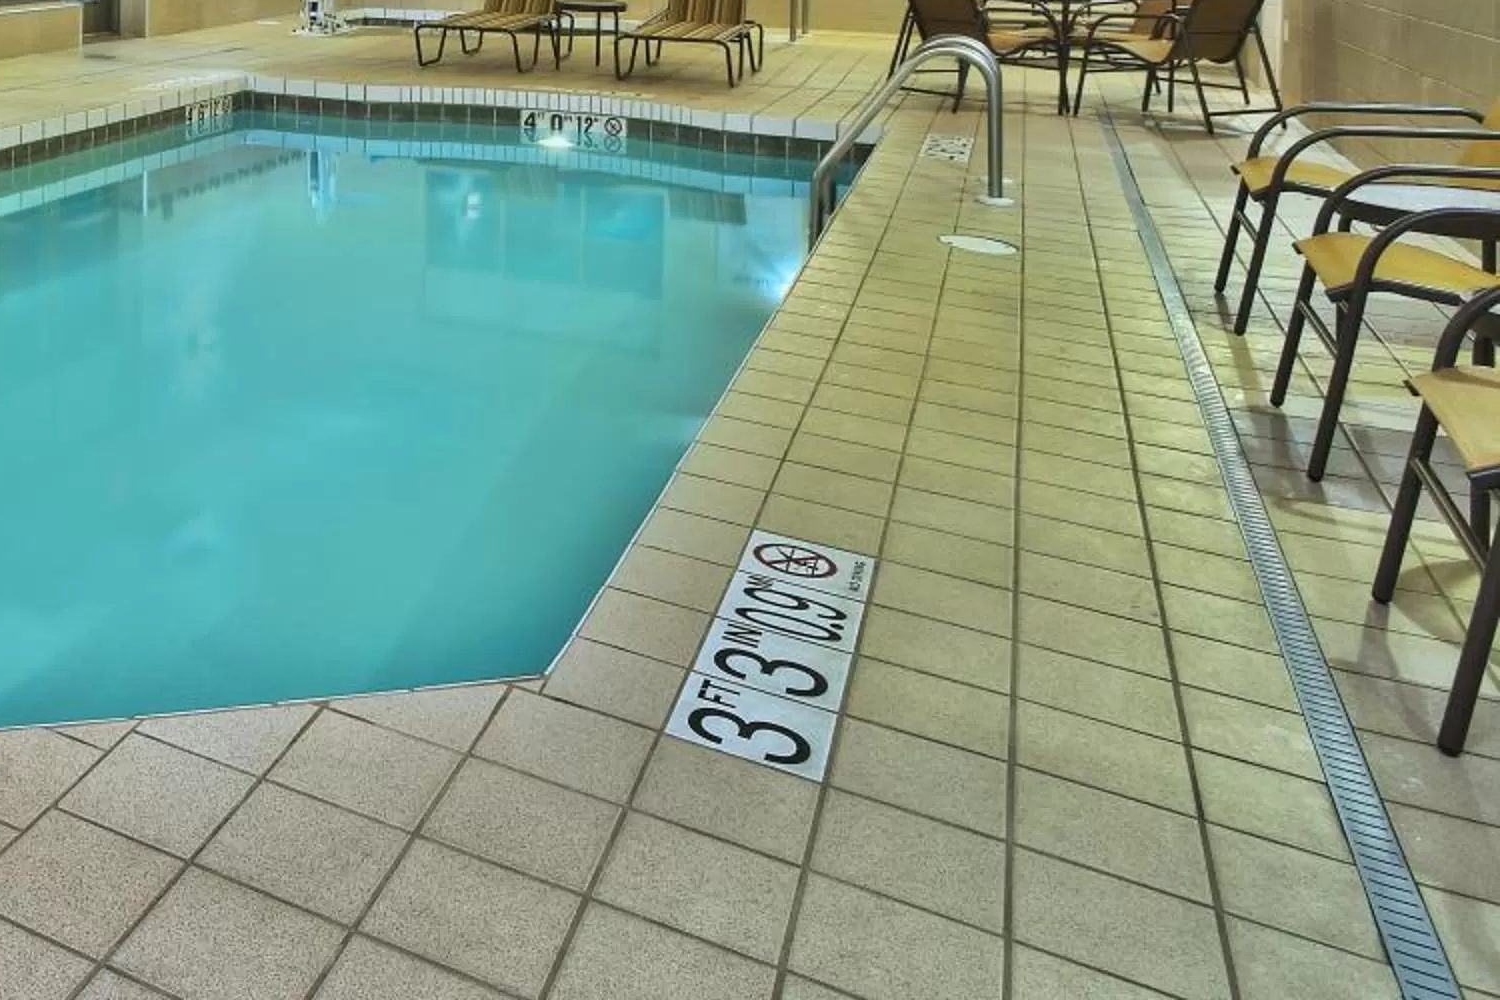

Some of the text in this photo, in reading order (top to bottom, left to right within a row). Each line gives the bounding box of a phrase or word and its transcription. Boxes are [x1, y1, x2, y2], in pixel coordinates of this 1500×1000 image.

[524, 112, 536, 127] 4
[722, 621, 763, 648] IN
[735, 587, 848, 643] 0.9
[714, 647, 829, 697] 3
[697, 679, 741, 709] FT
[688, 706, 812, 765] 3
